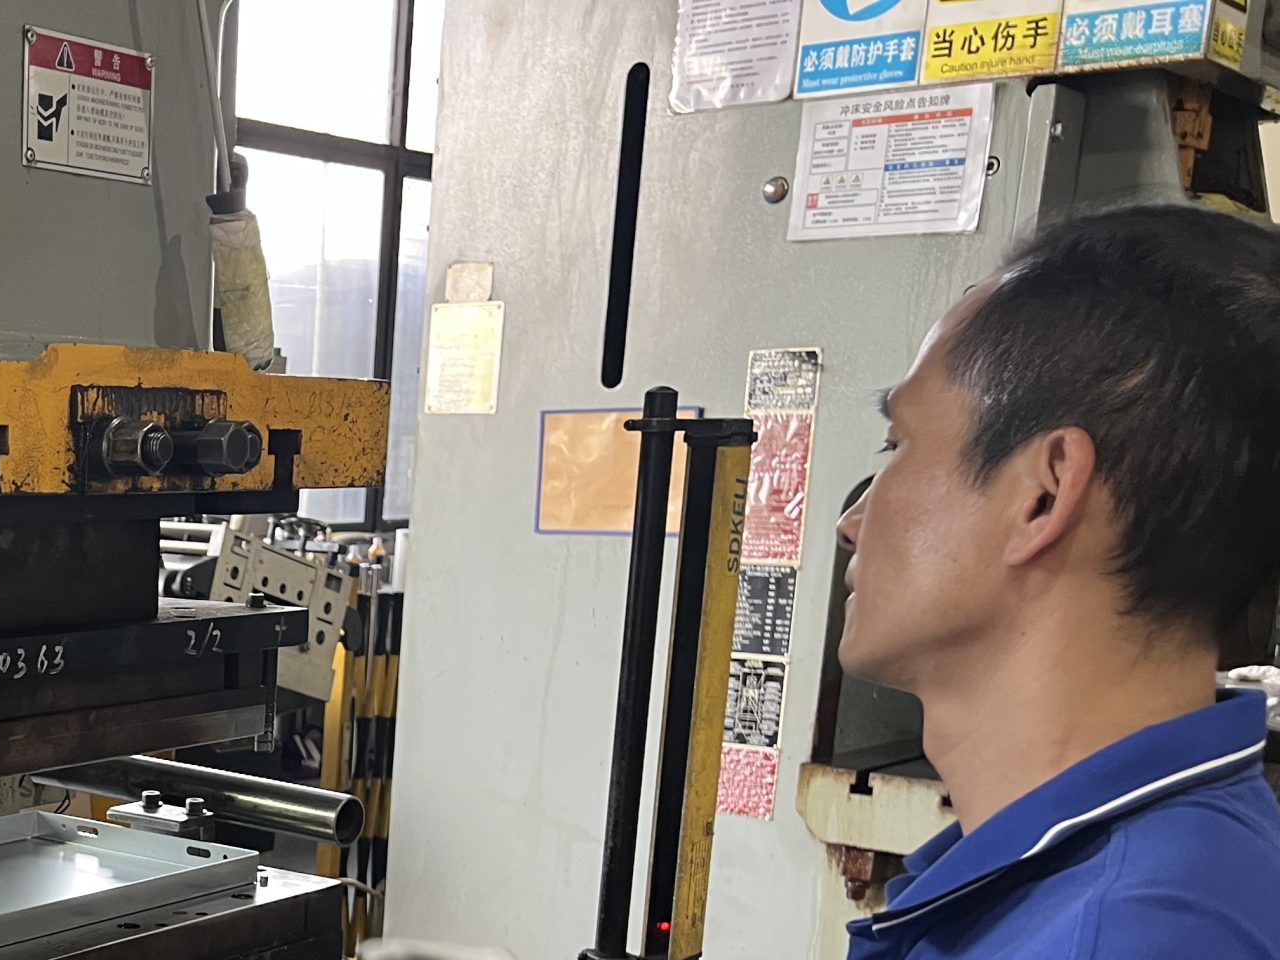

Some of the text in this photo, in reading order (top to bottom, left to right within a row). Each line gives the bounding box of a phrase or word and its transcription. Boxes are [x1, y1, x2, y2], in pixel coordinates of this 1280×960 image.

[930, 16, 1050, 59] 当心伤手
[1064, 2, 1203, 47] 必须戴耳塞
[93, 49, 121, 71] 警告
[803, 36, 916, 73] 必须戴防护手套
[940, 54, 1036, 74] Caution injure hand
[91, 66, 121, 82] WARNING
[840, 94, 951, 116] 冲床安全风险点告知牌
[727, 478, 748, 573] SDKELI
[184, 622, 225, 657] 2/2
